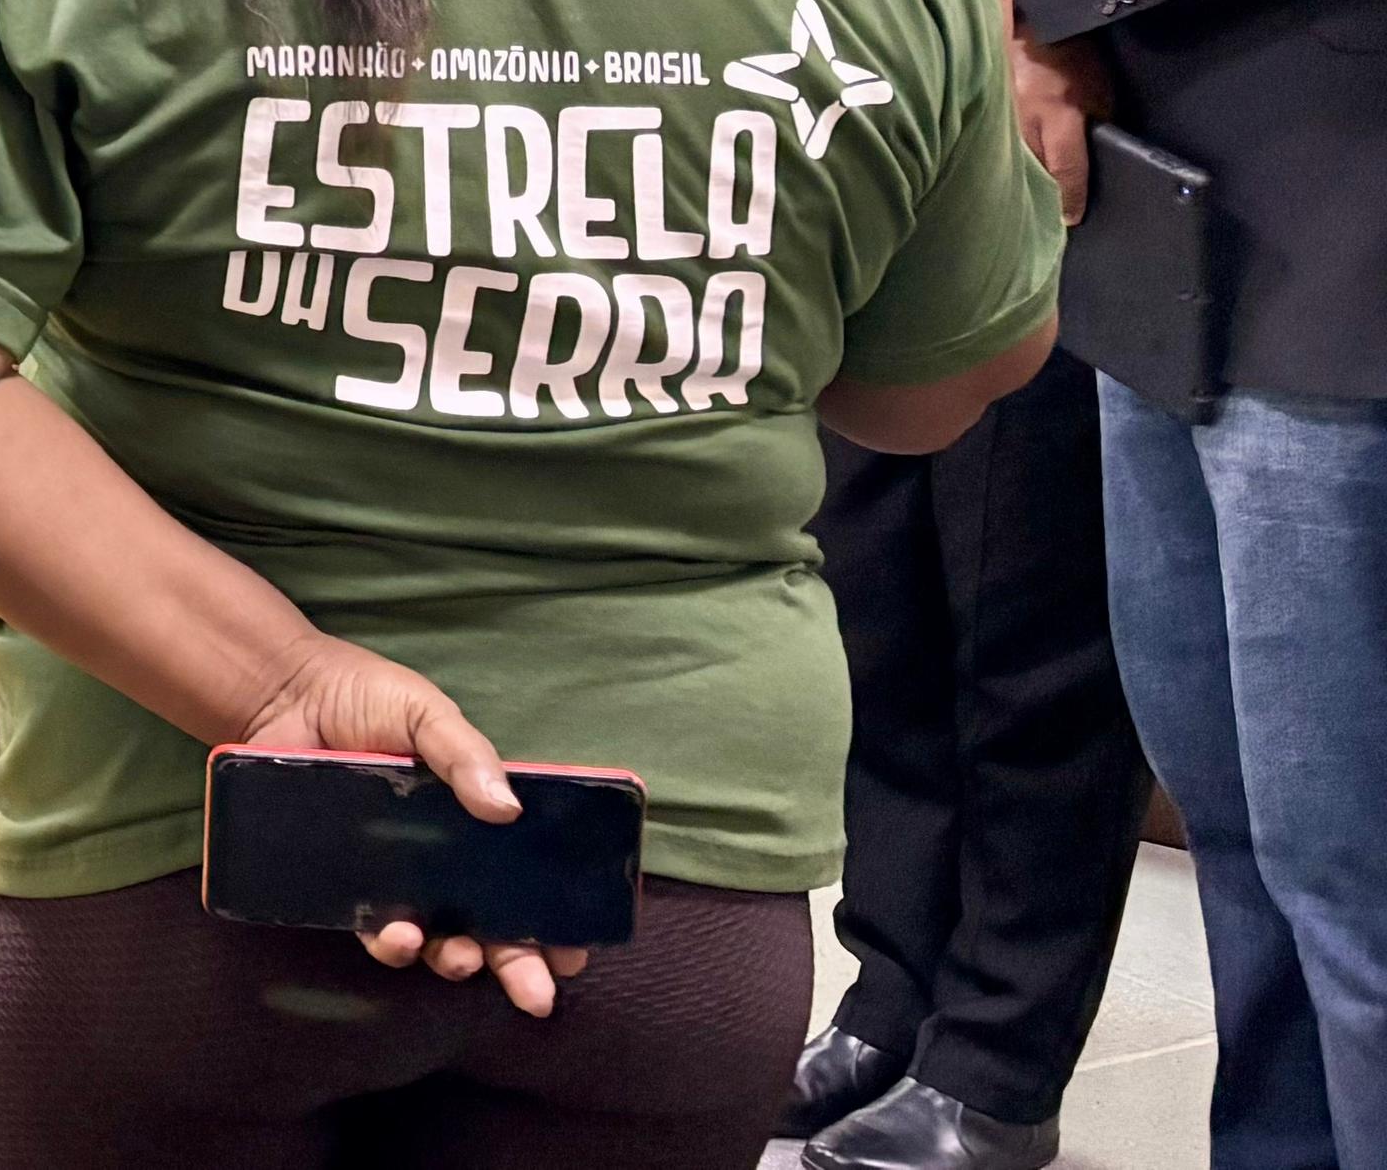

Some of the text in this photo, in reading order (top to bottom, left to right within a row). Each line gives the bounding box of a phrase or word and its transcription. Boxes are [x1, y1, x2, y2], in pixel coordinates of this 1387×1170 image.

[246, 40, 407, 80] MARANHÃO
[603, 50, 711, 86] BRASIL
[235, 95, 778, 261] ESTRELA
[334, 256, 767, 419] SERRA
